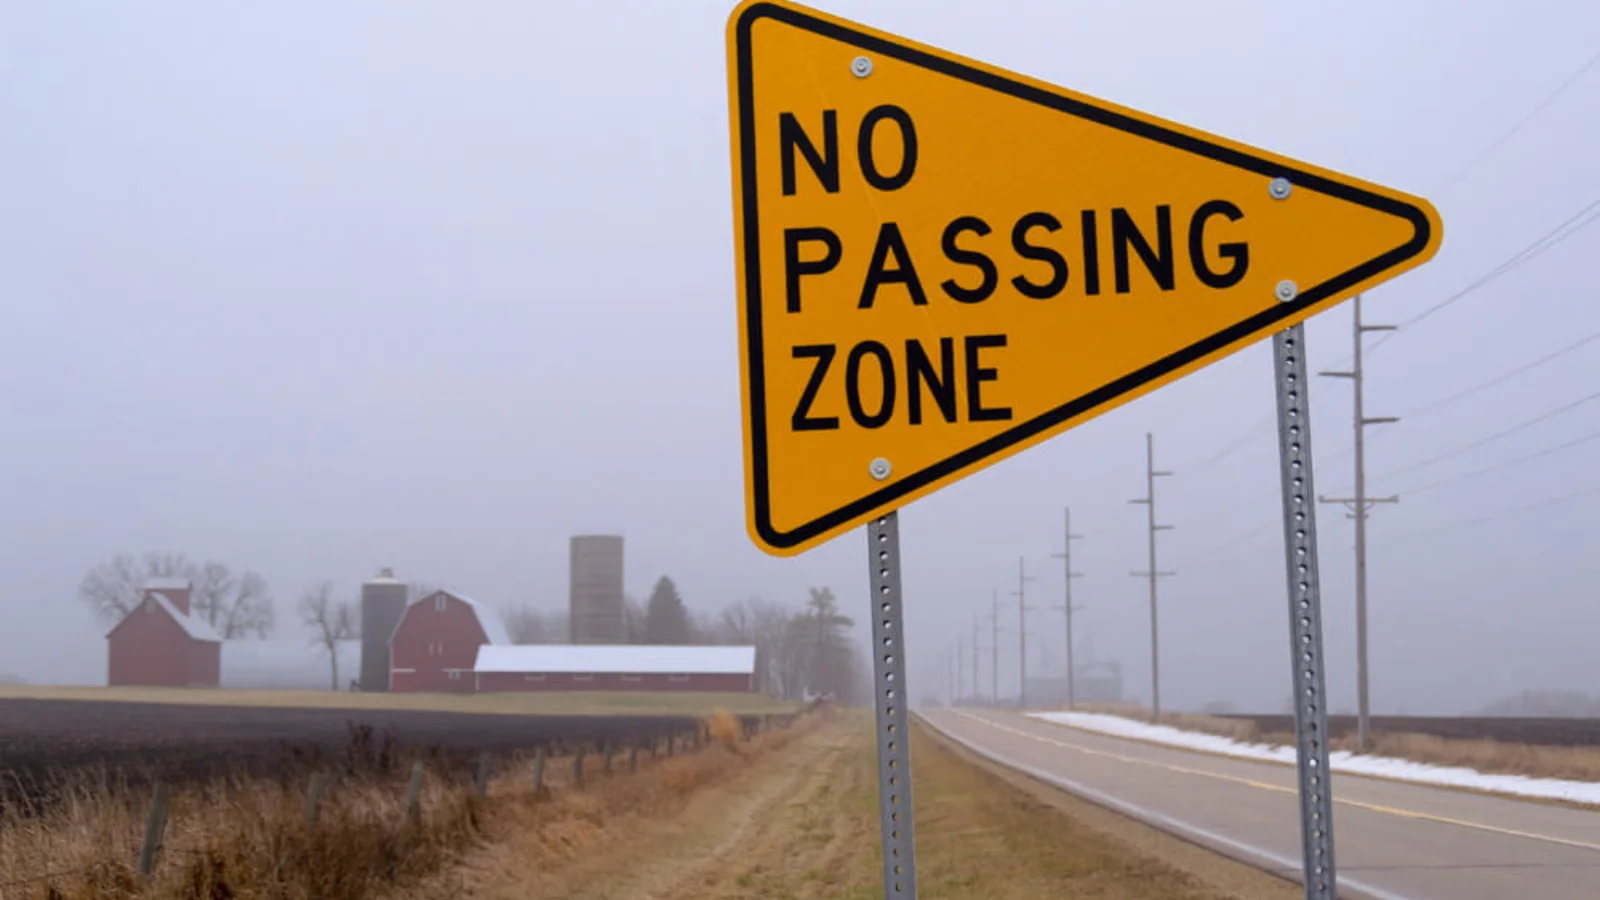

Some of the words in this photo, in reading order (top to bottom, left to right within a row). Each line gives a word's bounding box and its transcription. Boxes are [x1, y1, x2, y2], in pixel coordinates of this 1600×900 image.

[779, 105, 918, 196] NO
[784, 200, 1249, 313] PASSING
[792, 334, 1012, 431] ZONE
